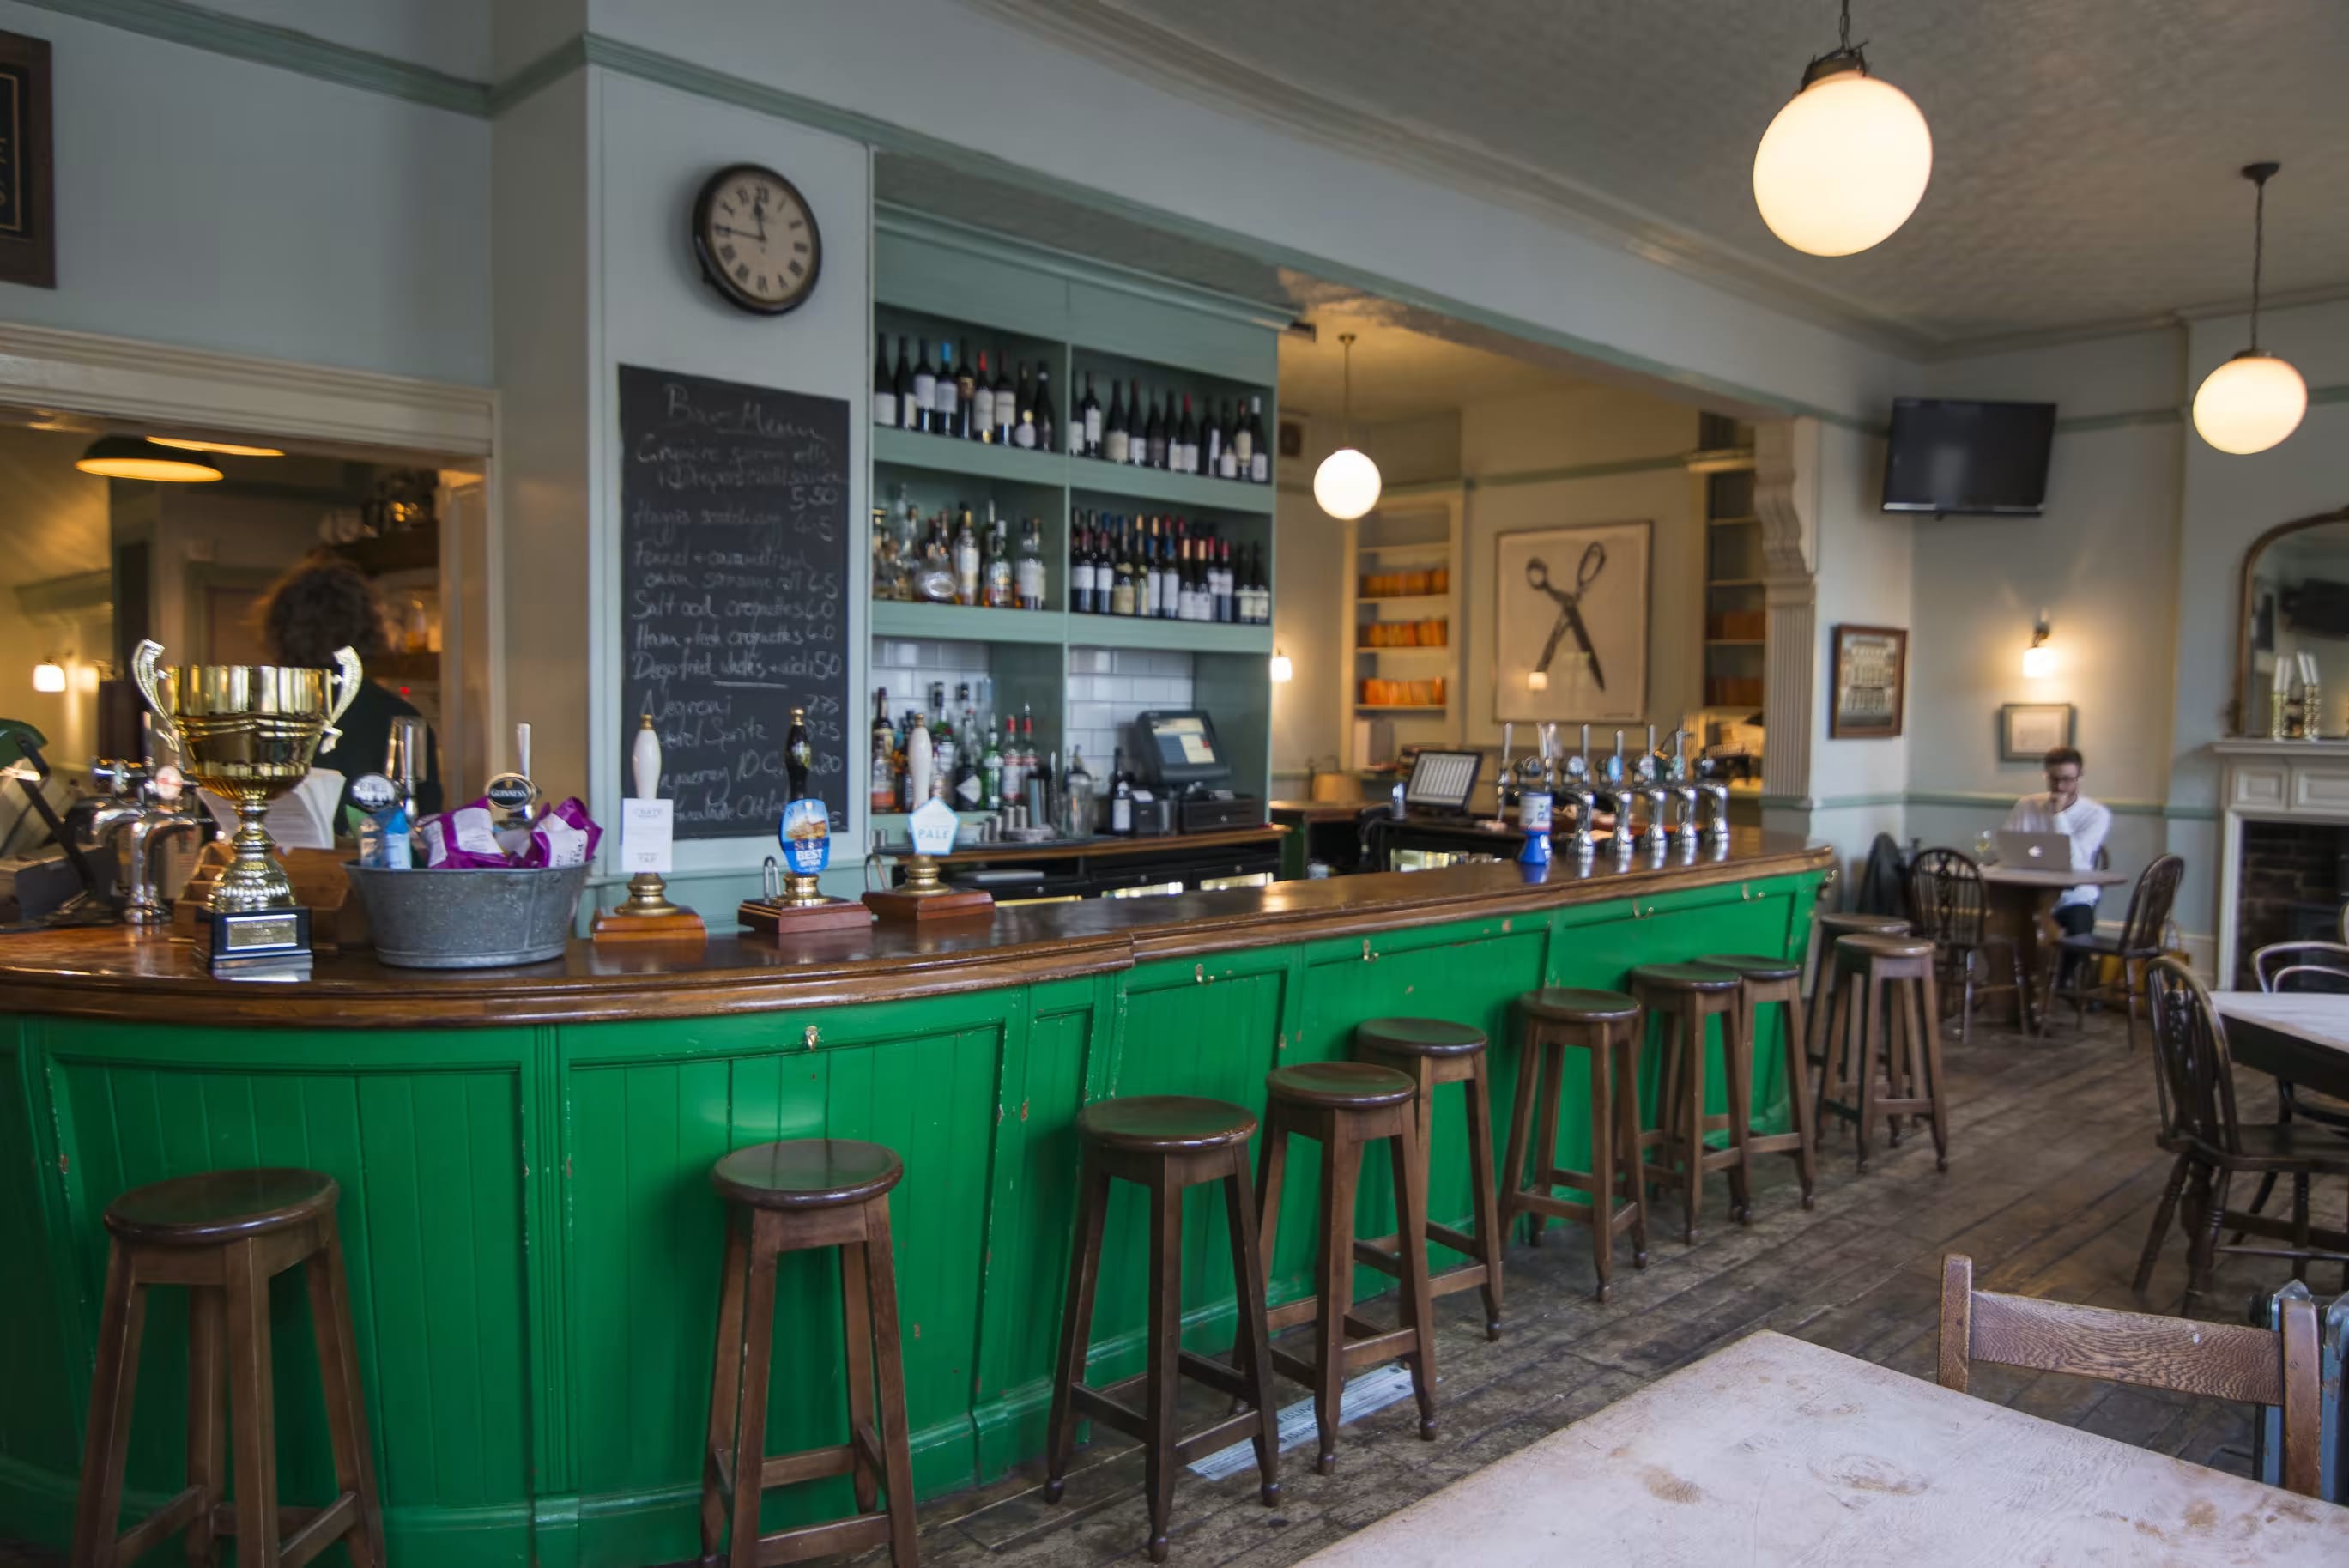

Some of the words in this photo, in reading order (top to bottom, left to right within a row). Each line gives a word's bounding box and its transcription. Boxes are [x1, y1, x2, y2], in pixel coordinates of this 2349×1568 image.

[632, 590, 675, 620] Salt
[681, 594, 719, 620] cod
[636, 623, 681, 649] Ham
[640, 689, 731, 736] Negroni
[490, 789, 527, 798] GUINNESS
[918, 829, 949, 838] PALE
[796, 849, 823, 861] BEST
